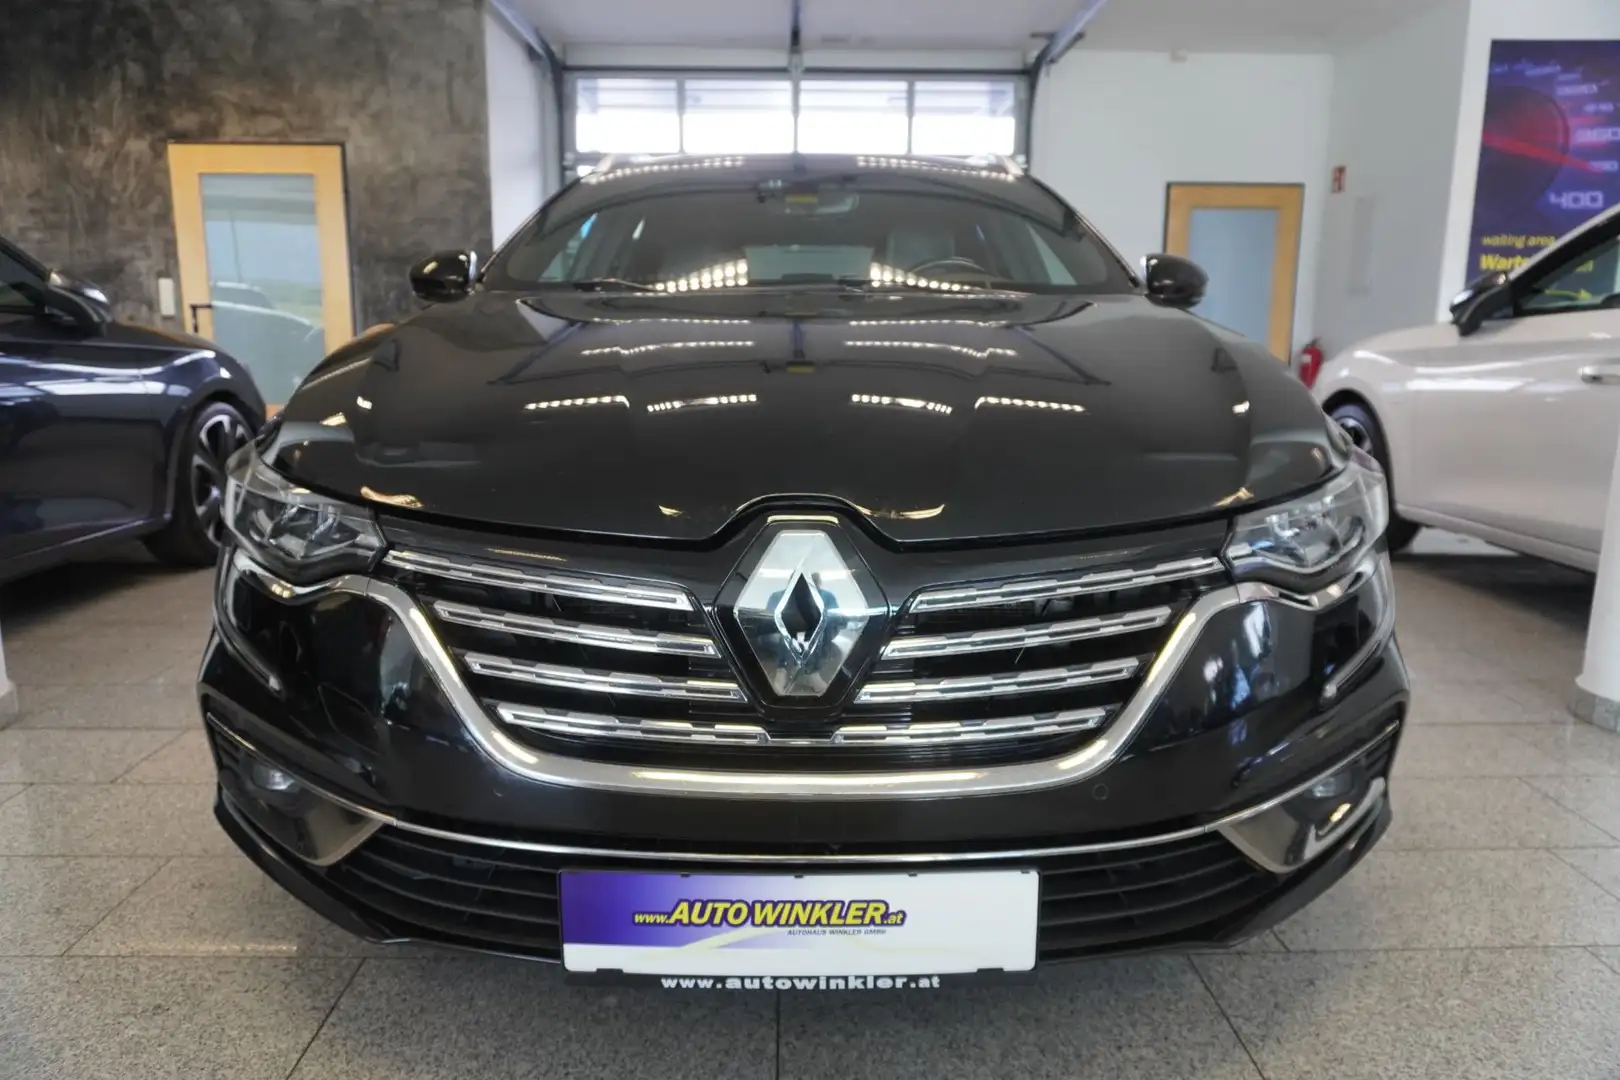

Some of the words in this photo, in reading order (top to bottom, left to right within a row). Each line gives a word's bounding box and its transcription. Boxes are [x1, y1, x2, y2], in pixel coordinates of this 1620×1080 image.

[1549, 191, 1604, 209] 400
[1482, 235, 1525, 248] waiting
[661, 976, 941, 990] www.autowinkler.at
